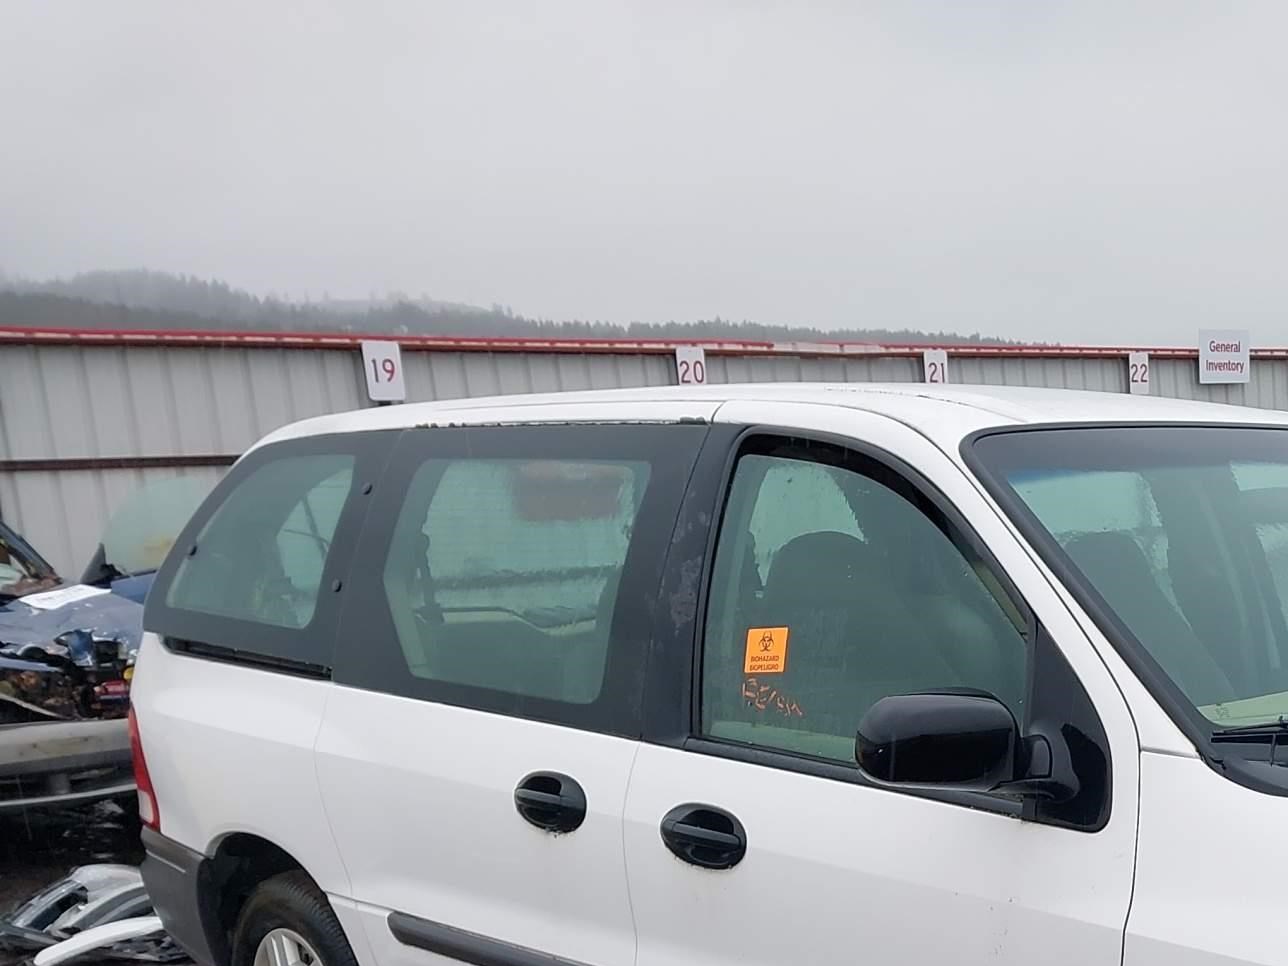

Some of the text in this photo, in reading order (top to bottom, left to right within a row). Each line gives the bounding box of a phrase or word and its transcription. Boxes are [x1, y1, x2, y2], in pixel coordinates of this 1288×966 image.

[1209, 340, 1241, 353] General
[371, 358, 395, 383] 19
[678, 360, 705, 384] 20
[928, 362, 945, 383] 21
[1130, 363, 1148, 383] 22
[1205, 360, 1245, 374] Inventory
